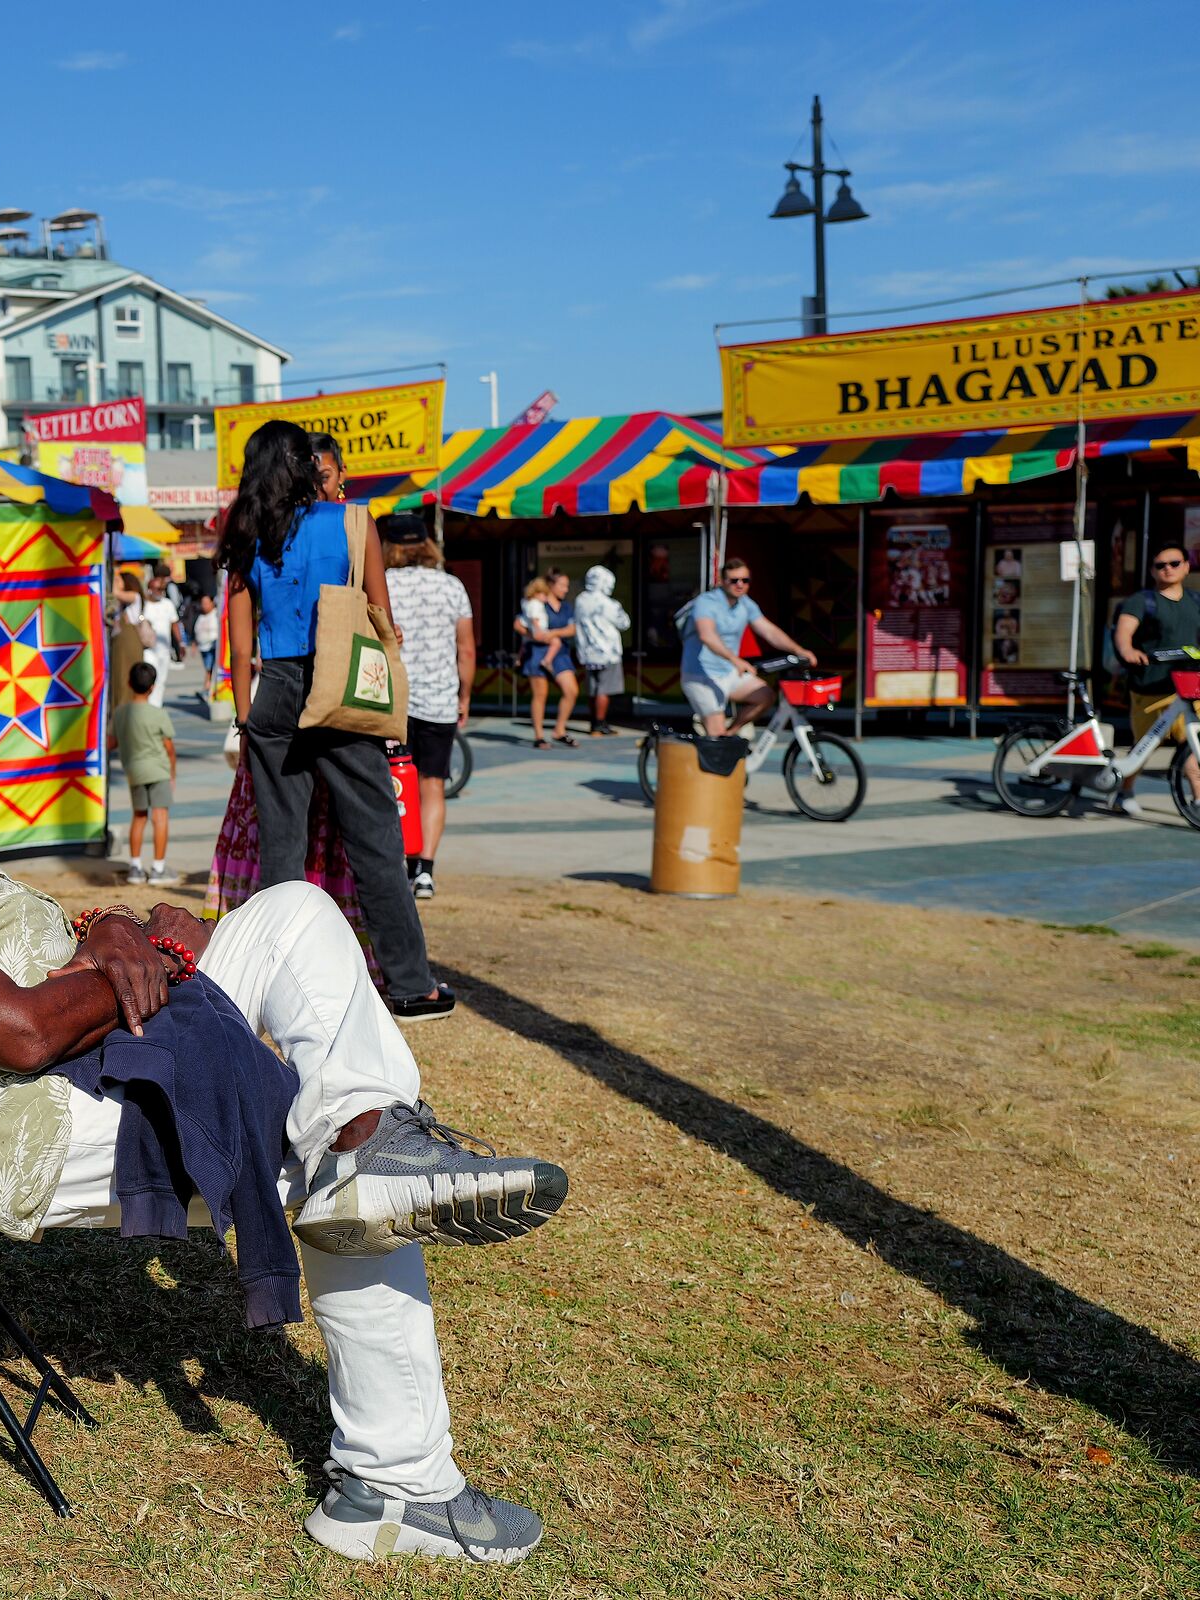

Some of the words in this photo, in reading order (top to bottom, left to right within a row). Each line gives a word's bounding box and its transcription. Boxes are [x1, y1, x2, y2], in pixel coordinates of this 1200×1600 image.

[838, 353, 1158, 414] BHAGAVAD
[93, 400, 141, 432] CORN
[360, 410, 388, 429] OF
